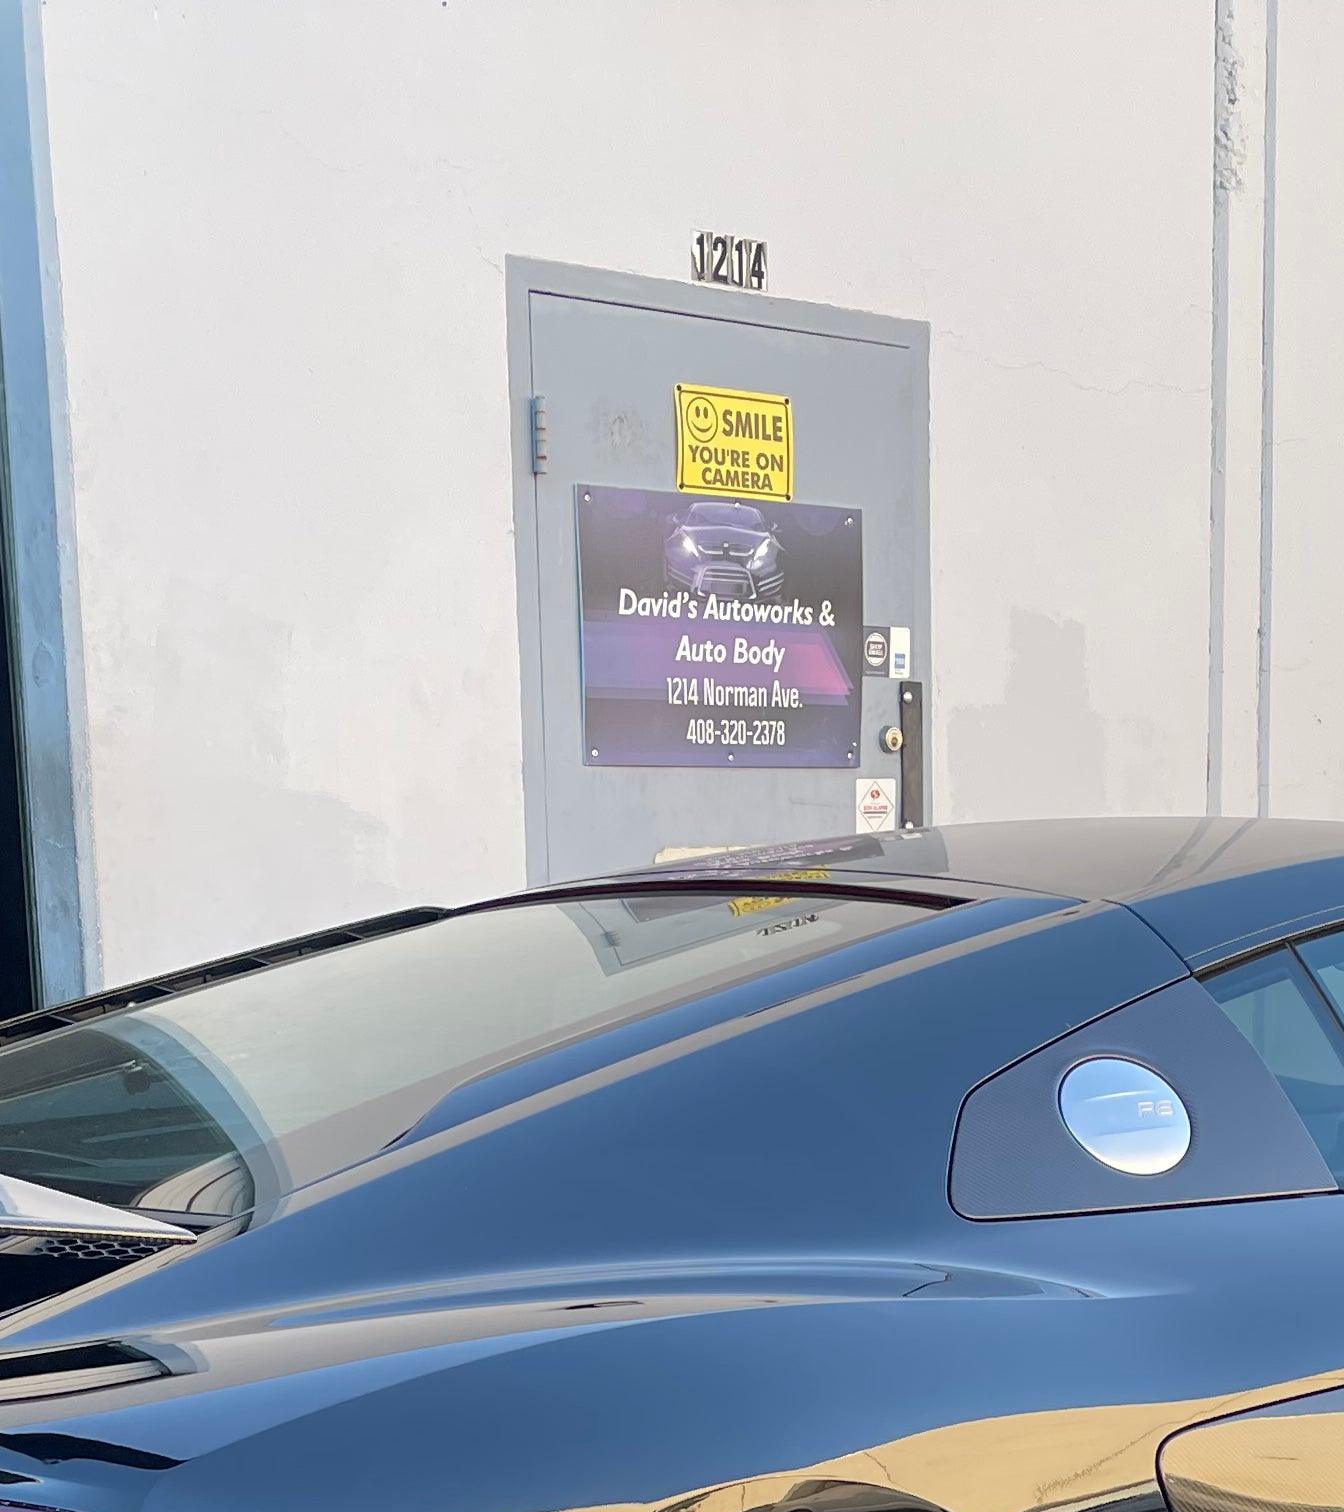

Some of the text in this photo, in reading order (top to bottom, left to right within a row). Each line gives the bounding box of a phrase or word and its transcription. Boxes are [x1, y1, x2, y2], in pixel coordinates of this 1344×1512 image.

[696, 233, 765, 290] 1214
[722, 409, 783, 442] SMILE
[688, 444, 784, 482] YOU'RE ON
[701, 466, 773, 491] CAMERA
[618, 588, 835, 627] David's Autoworks &
[675, 635, 785, 673] Auto Body
[666, 677, 803, 708] 1214 Norman Ave.
[686, 719, 786, 746] 408-320-2378
